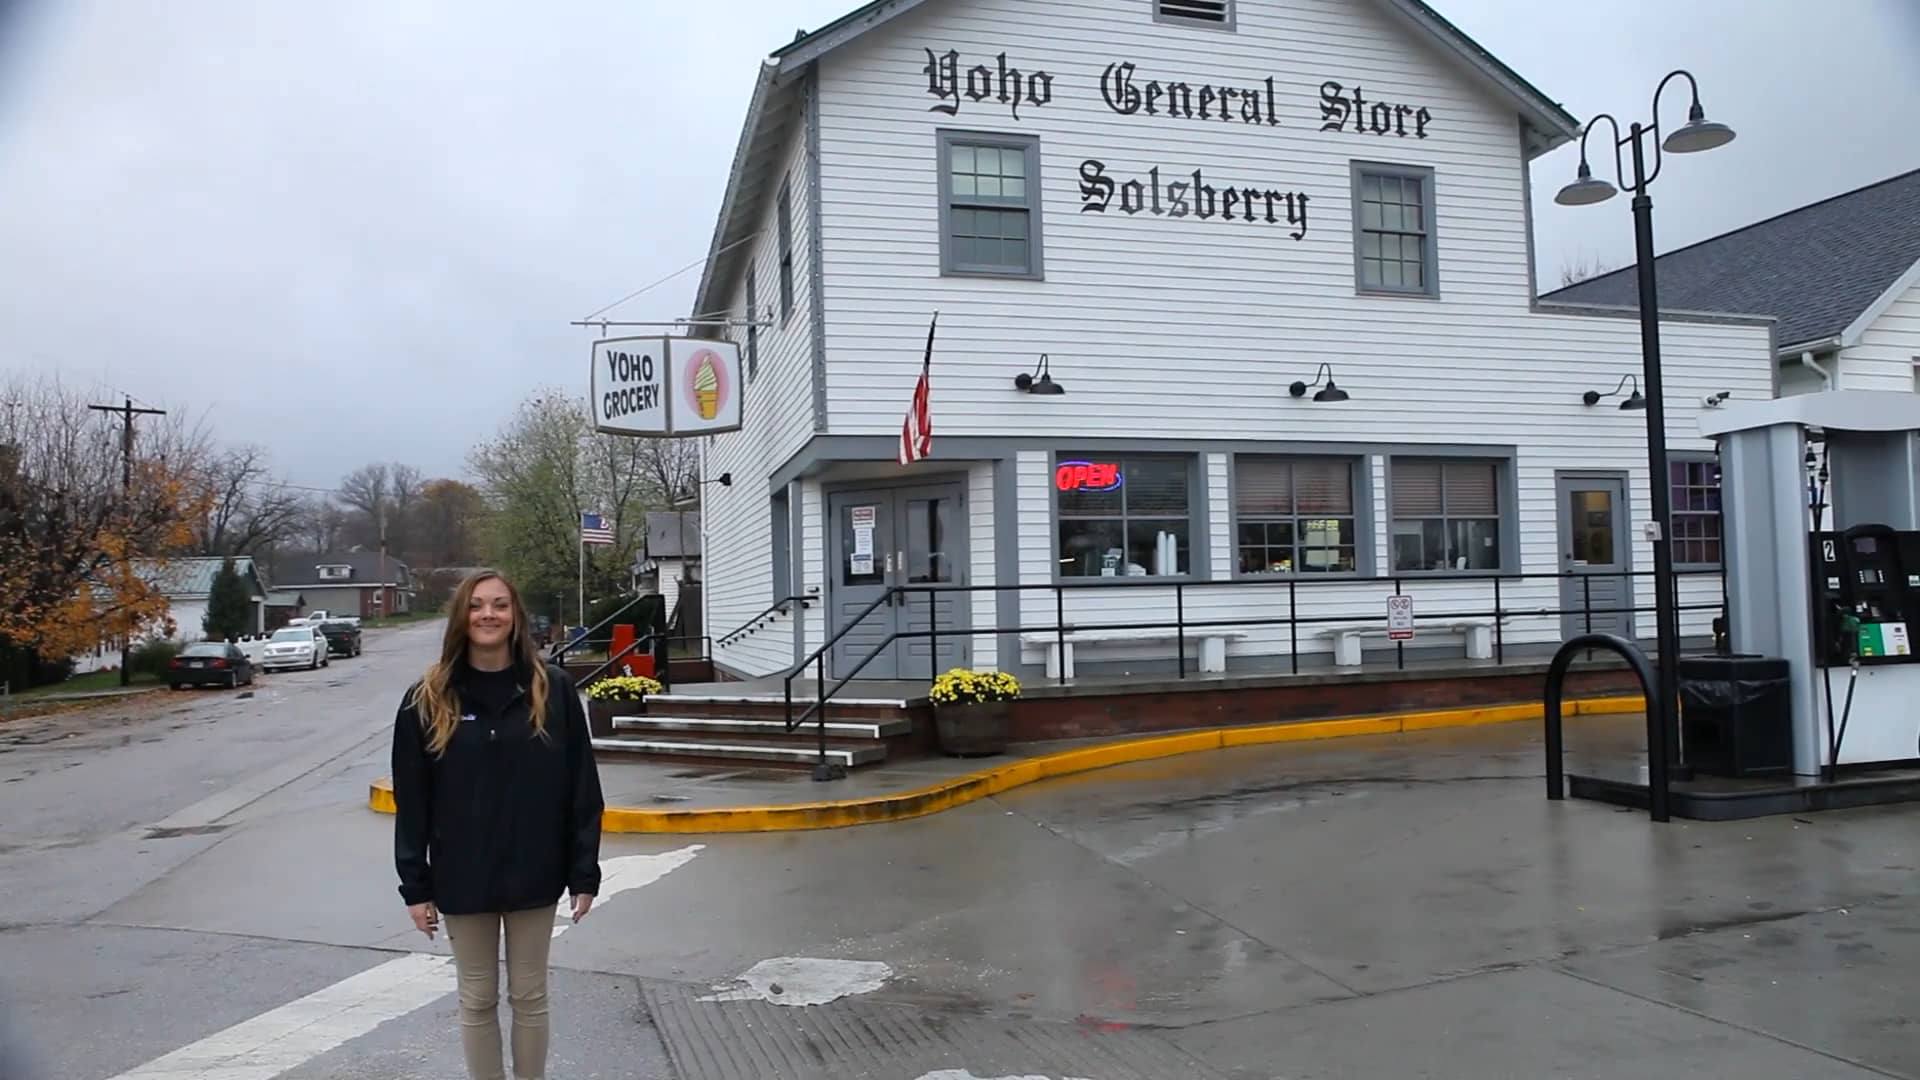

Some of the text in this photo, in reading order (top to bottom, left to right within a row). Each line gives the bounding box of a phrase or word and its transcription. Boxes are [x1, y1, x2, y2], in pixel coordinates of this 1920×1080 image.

[924, 47, 1432, 139] Yoho General Store
[1078, 159, 1309, 241] Solsberry
[607, 350, 653, 382] YOHO
[604, 383, 659, 420] GROCERY
[1056, 464, 1117, 491] OPEN
[1824, 542, 1834, 560] 2
